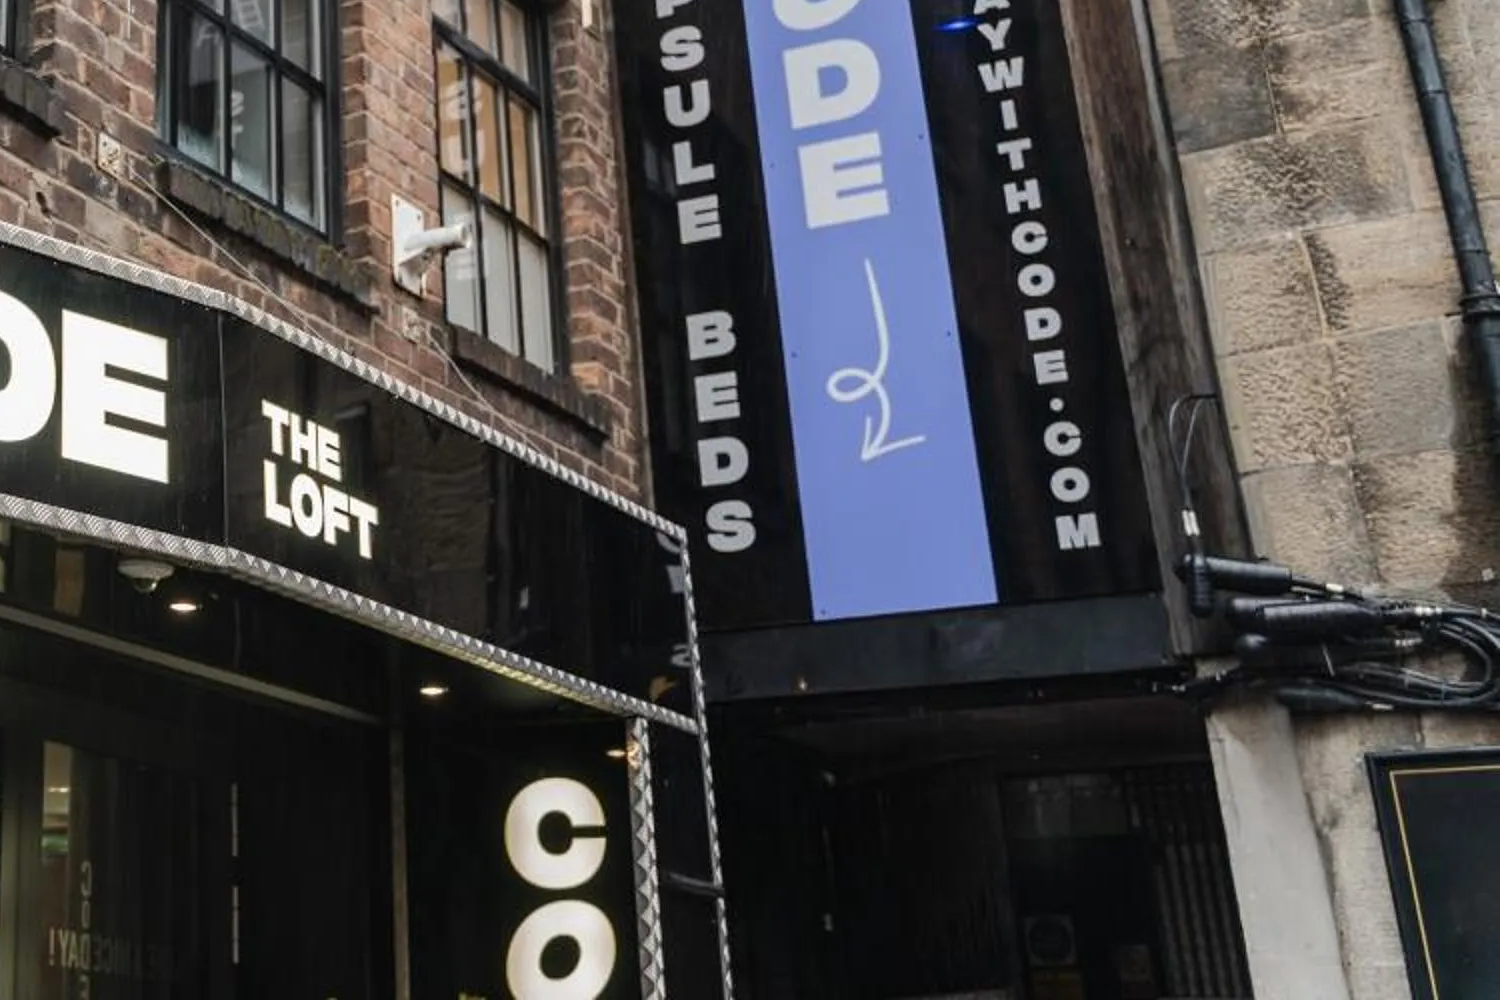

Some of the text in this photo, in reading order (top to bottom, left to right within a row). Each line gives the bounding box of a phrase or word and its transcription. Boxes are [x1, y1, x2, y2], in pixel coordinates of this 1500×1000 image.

[261, 400, 342, 481] THE
[686, 311, 755, 552] BEDS
[263, 459, 379, 559] LOFT
